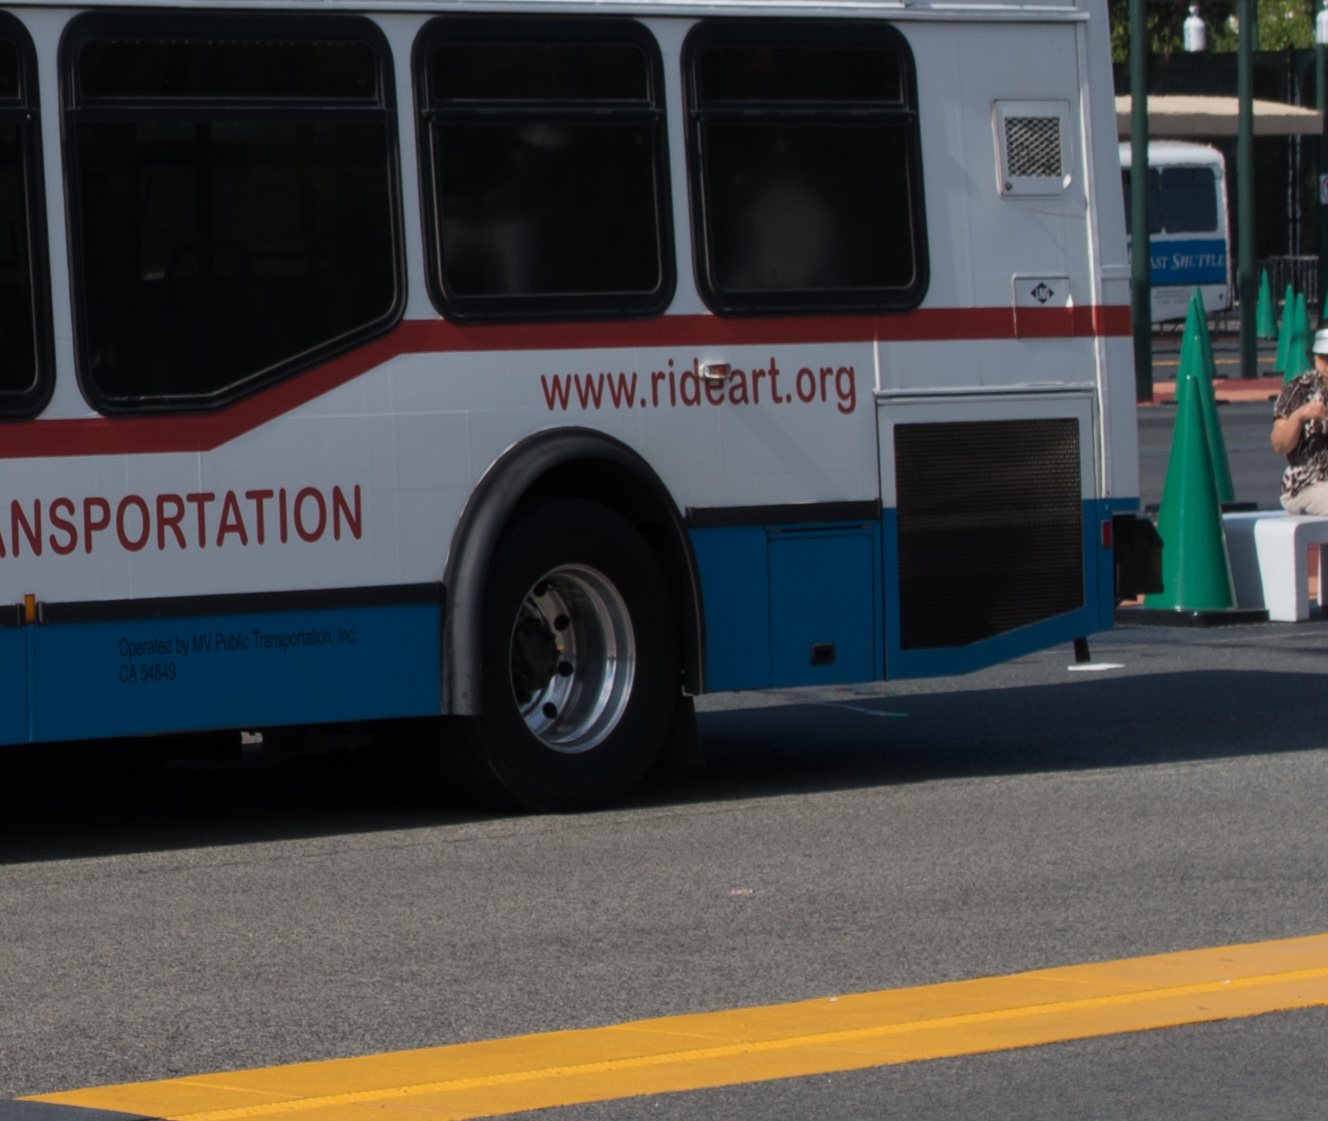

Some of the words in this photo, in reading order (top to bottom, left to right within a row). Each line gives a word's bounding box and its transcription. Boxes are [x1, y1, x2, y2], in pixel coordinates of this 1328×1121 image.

[540, 356, 857, 415] www.rideart.org
[119, 637, 173, 660] Operated
[175, 636, 189, 658] by
[192, 634, 212, 653] MV
[215, 632, 250, 652] Public
[252, 627, 335, 653] Transportation,
[337, 625, 358, 644] Inc.
[118, 664, 137, 684] CA
[140, 661, 177, 683] 54849
